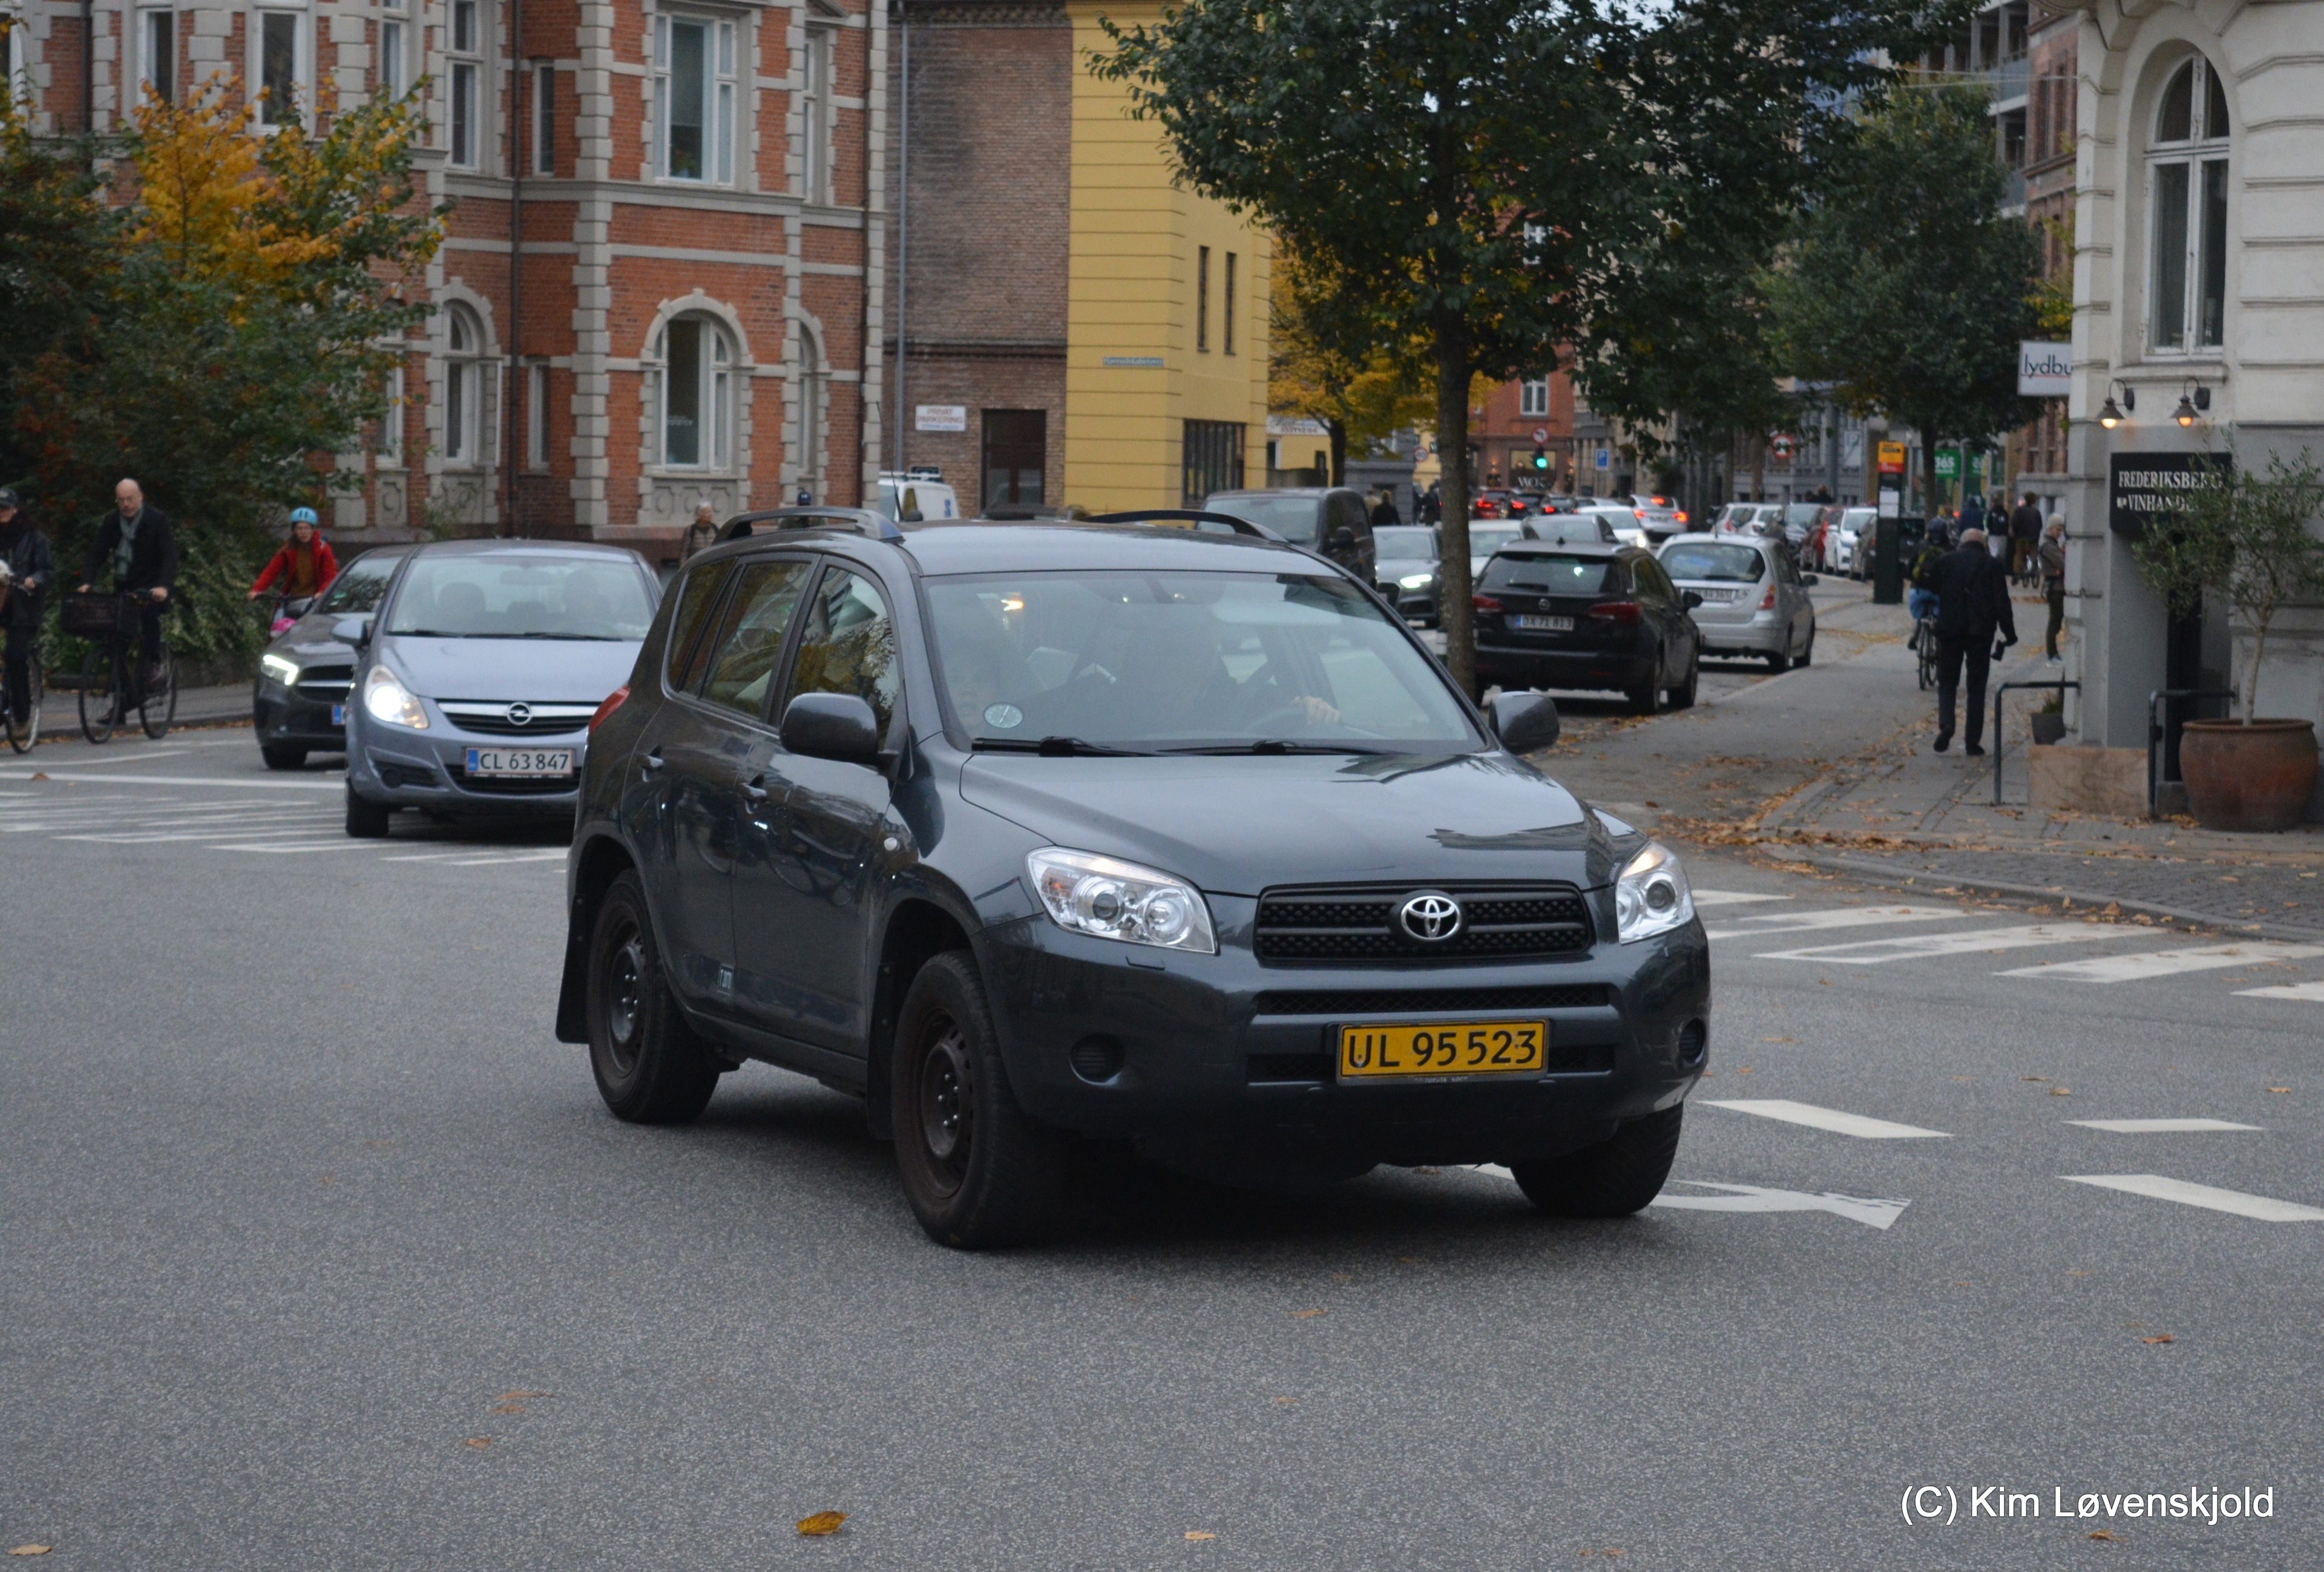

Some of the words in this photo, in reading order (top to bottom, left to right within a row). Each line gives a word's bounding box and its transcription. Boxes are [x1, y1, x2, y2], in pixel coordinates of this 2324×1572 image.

[481, 753, 503, 769] CL
[509, 753, 530, 770] 63
[536, 753, 569, 770] 847
[1348, 1034, 1400, 1068] UL
[1412, 1032, 1457, 1067] 95
[1467, 1030, 1537, 1066] 523
